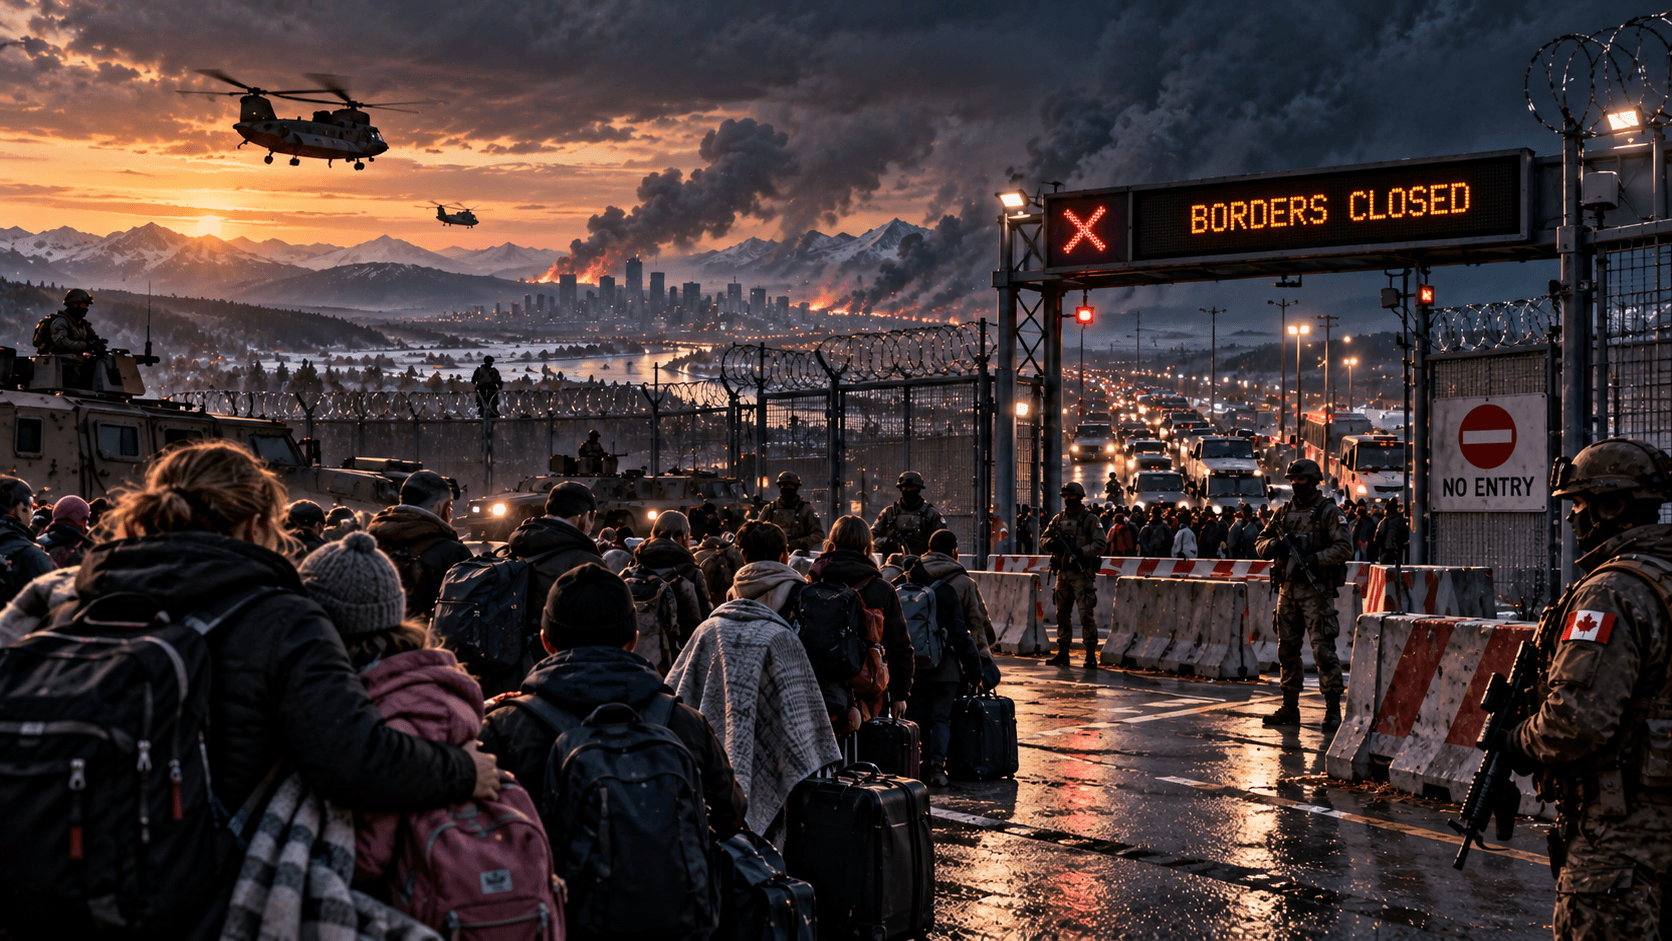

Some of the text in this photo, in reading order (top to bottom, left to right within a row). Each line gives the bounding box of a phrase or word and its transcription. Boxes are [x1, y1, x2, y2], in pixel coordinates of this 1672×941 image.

[1190, 181, 1470, 235] BORDERS CLOSED
[1442, 476, 1535, 498] NO ENTRY
